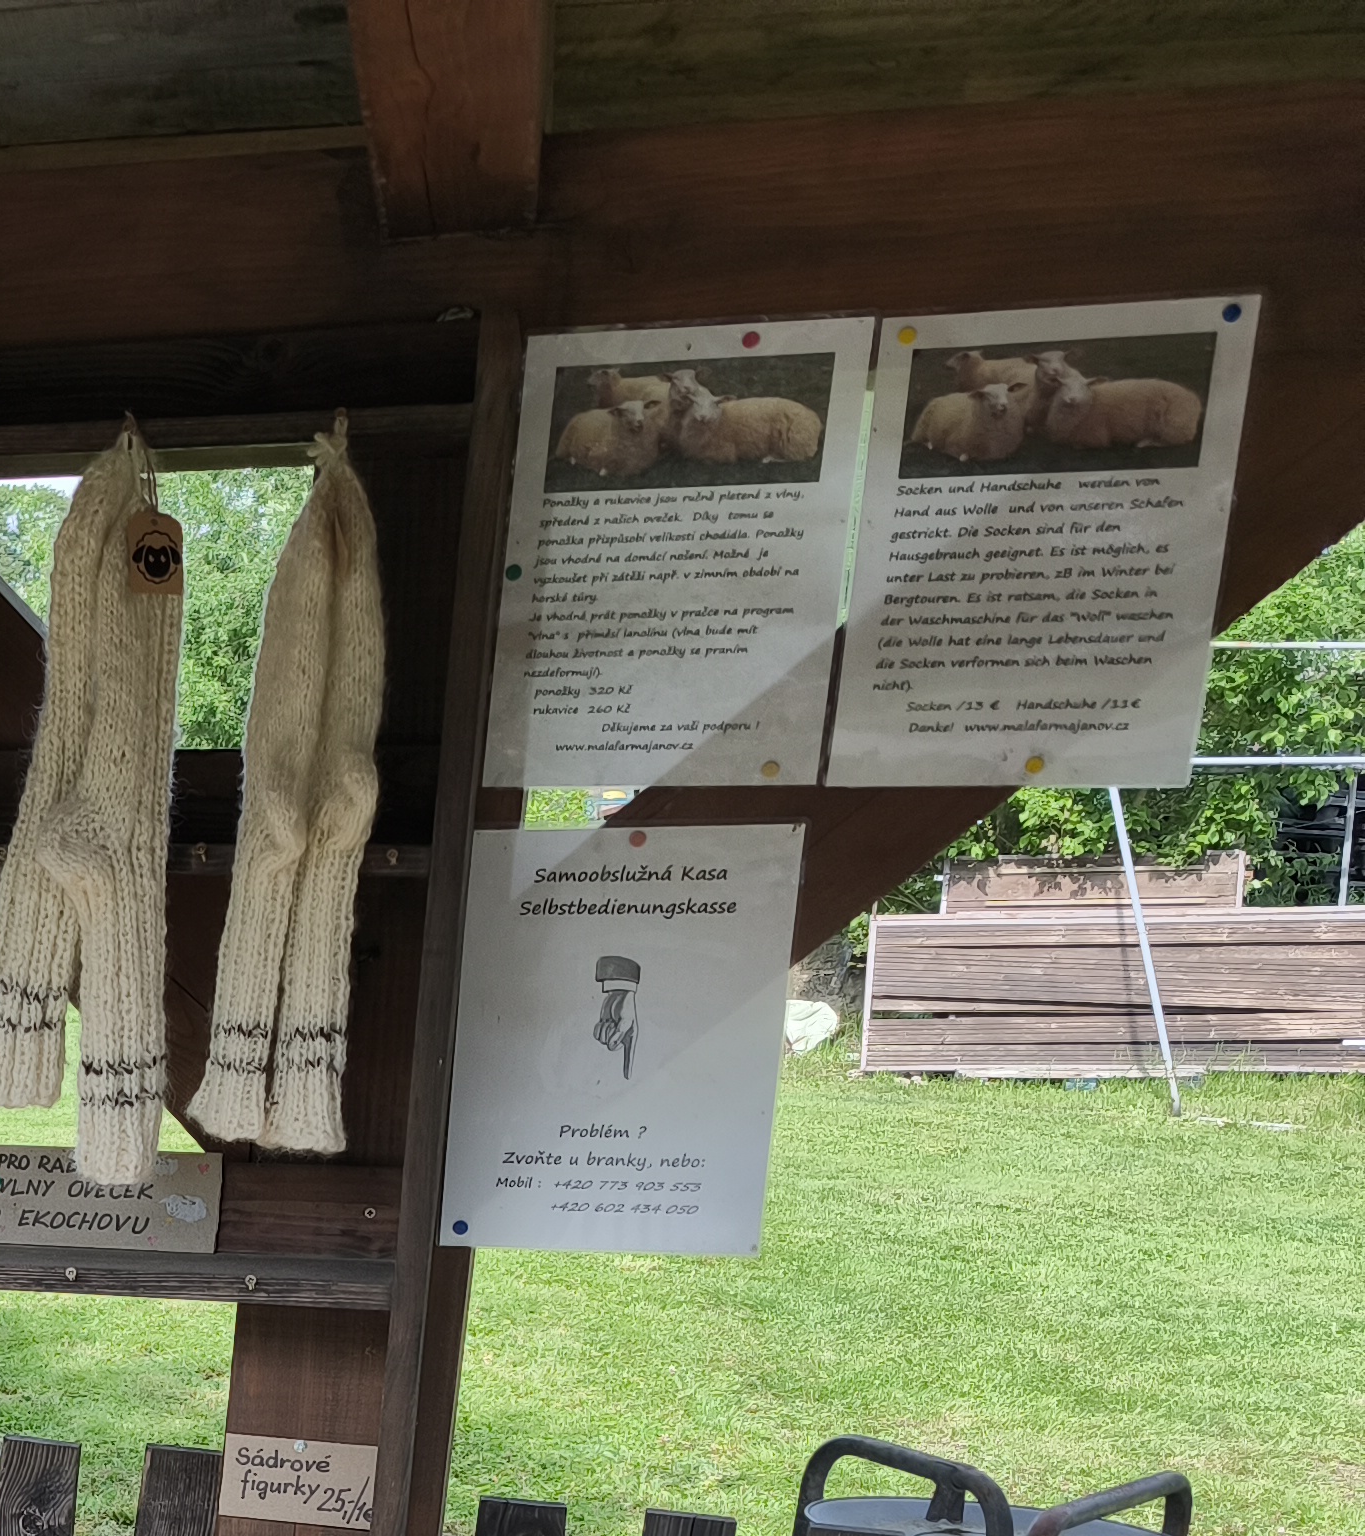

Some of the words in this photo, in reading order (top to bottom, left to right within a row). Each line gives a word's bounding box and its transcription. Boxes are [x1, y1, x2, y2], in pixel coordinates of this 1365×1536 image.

[897, 484, 943, 496] Socken
[949, 482, 974, 494] und
[894, 506, 930, 518] Hand
[935, 508, 957, 516] aus
[959, 526, 979, 538] Die
[619, 684, 633, 695] Kč
[533, 705, 578, 715] rukavice
[617, 704, 631, 713] Kč
[534, 864, 672, 883] Samoobslužná
[681, 866, 727, 881] Kasa
[519, 898, 737, 919] Selbstbedienungskasse
[559, 1124, 629, 1139] Problém
[637, 1126, 647, 1139] ?
[502, 1150, 562, 1165] Zvoňte
[570, 1157, 578, 1166] u
[587, 1152, 652, 1171] branky,
[660, 1154, 706, 1168] nebo:
[0, 1178, 55, 1197] VLNY
[496, 1177, 533, 1188] Mobil
[554, 1180, 593, 1189] +420
[599, 1181, 628, 1190] 773
[635, 1182, 664, 1191] 903
[551, 1202, 590, 1212] +420
[595, 1203, 625, 1213] 602
[631, 1204, 662, 1214] 434
[666, 1205, 699, 1214] 050
[18, 1208, 150, 1235] EKOCHOVU
[236, 1447, 332, 1472] Sádrové
[241, 1469, 320, 1504] figurky
